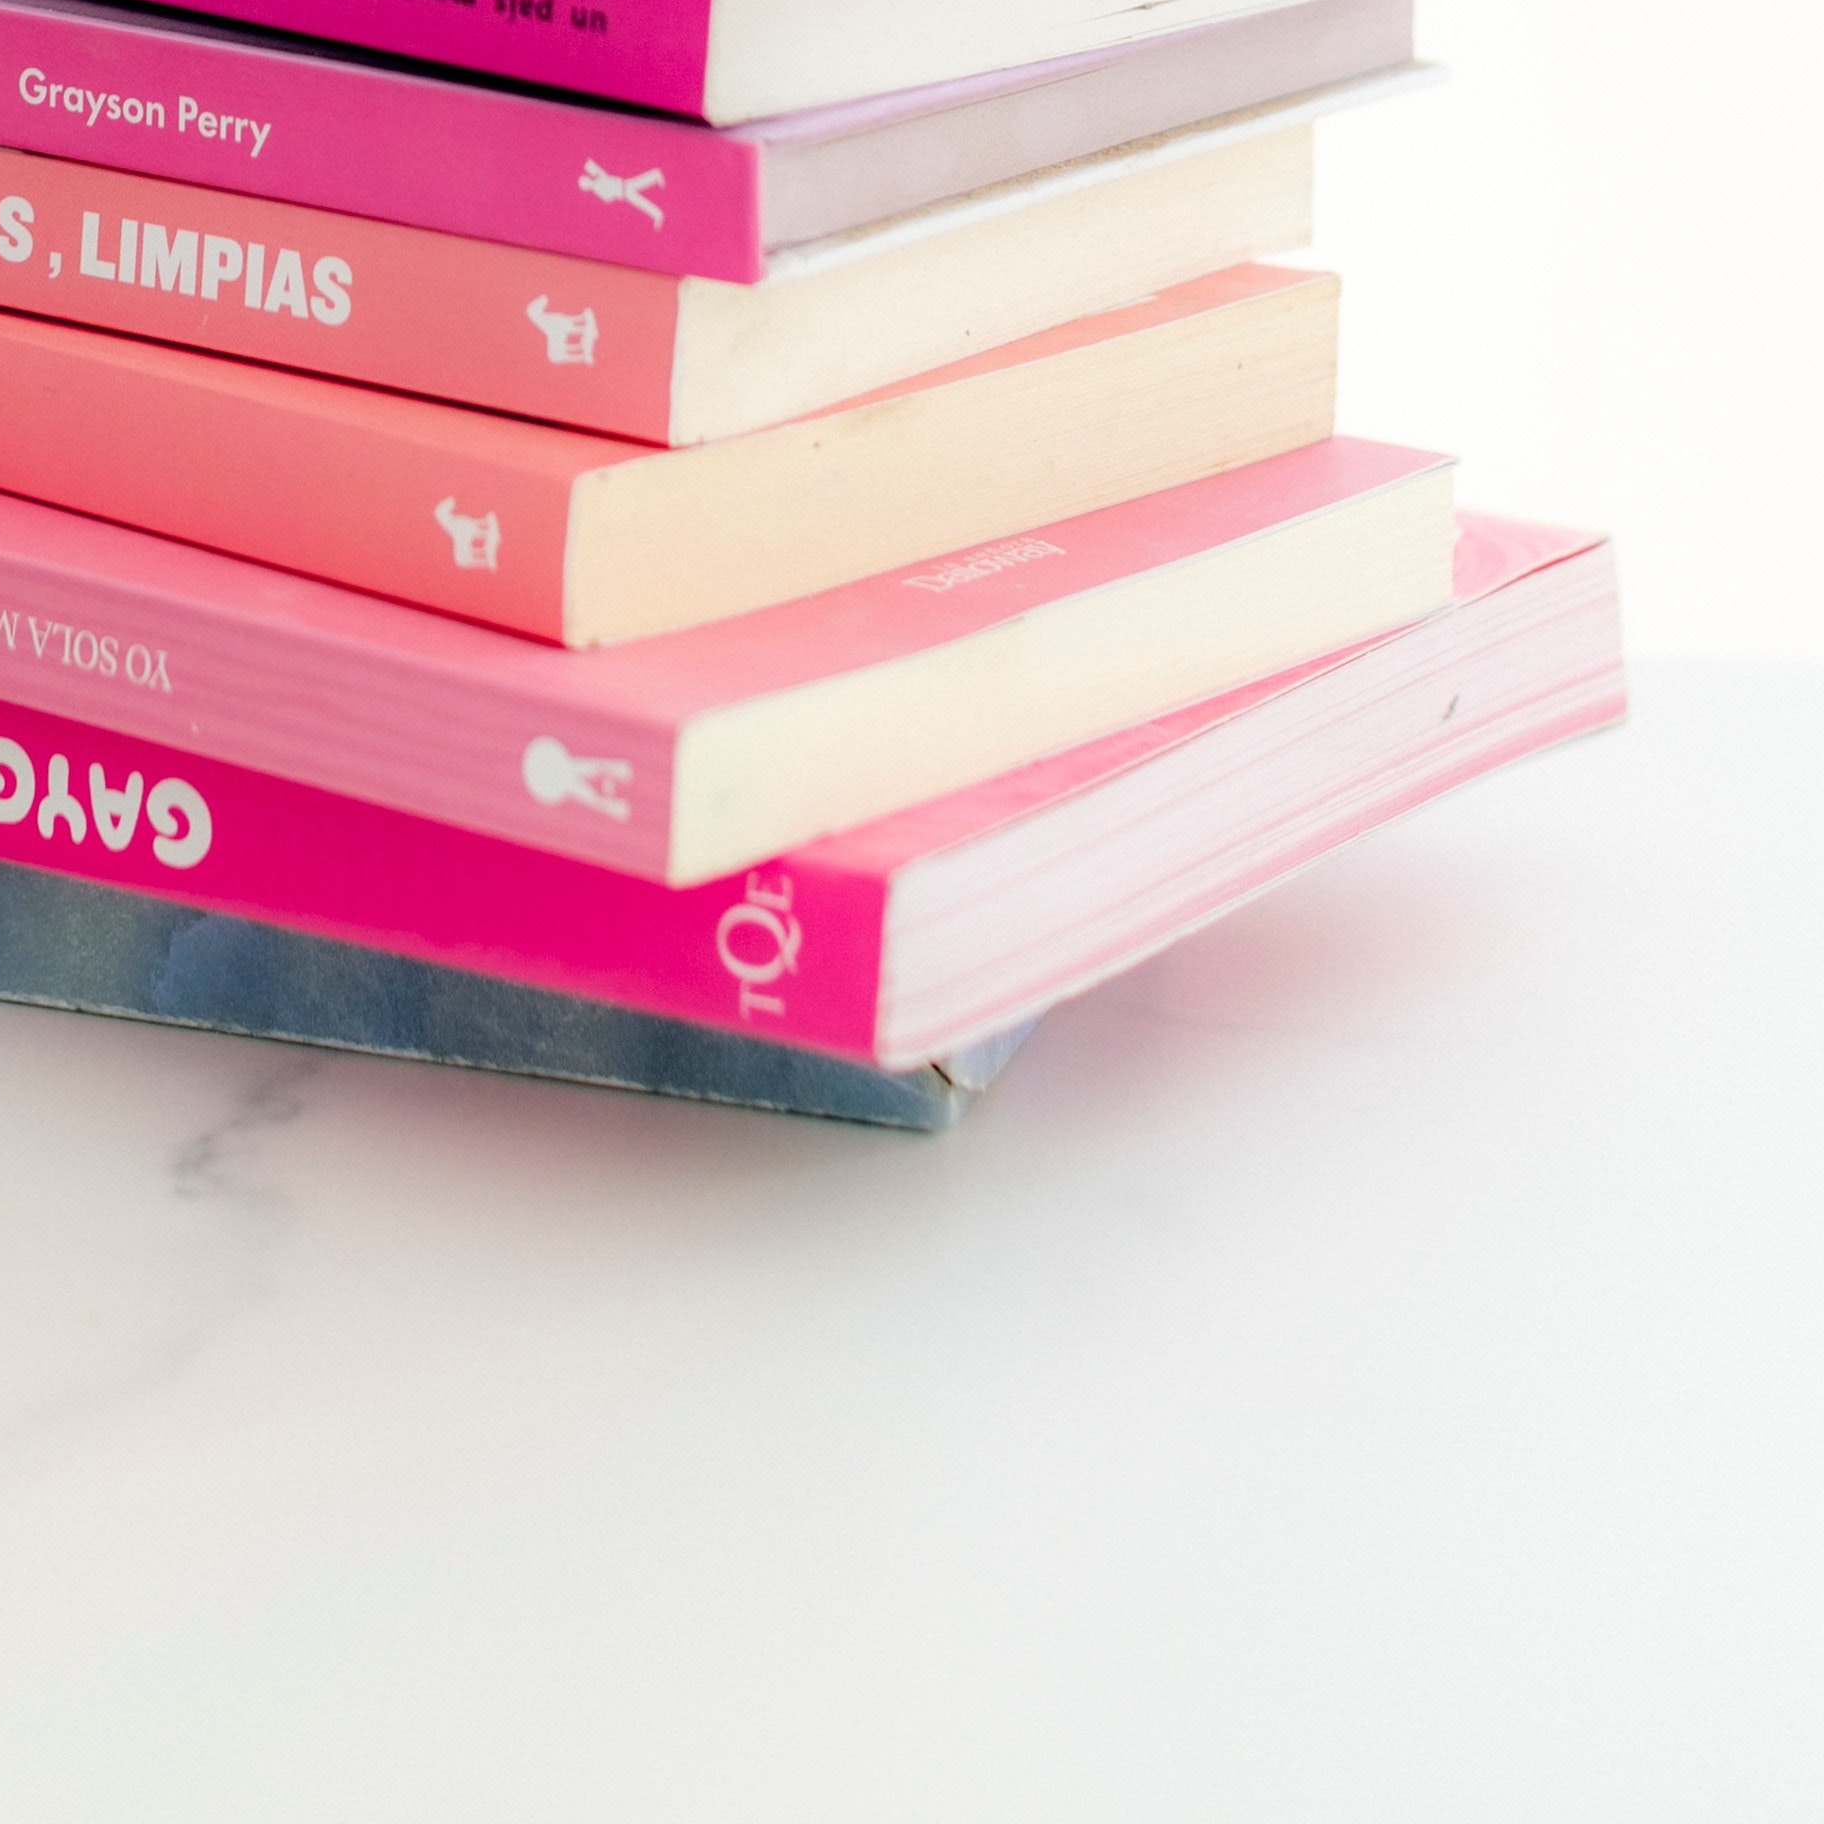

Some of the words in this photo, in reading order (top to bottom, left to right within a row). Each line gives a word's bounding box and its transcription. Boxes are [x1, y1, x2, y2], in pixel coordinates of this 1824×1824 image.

[569, 2, 608, 32] un
[18, 67, 165, 130] Grayson
[178, 95, 272, 158] Perry
[79, 210, 354, 326] LIMPIAS
[28, 615, 119, 677] SOLA
[125, 642, 173, 694] YO
